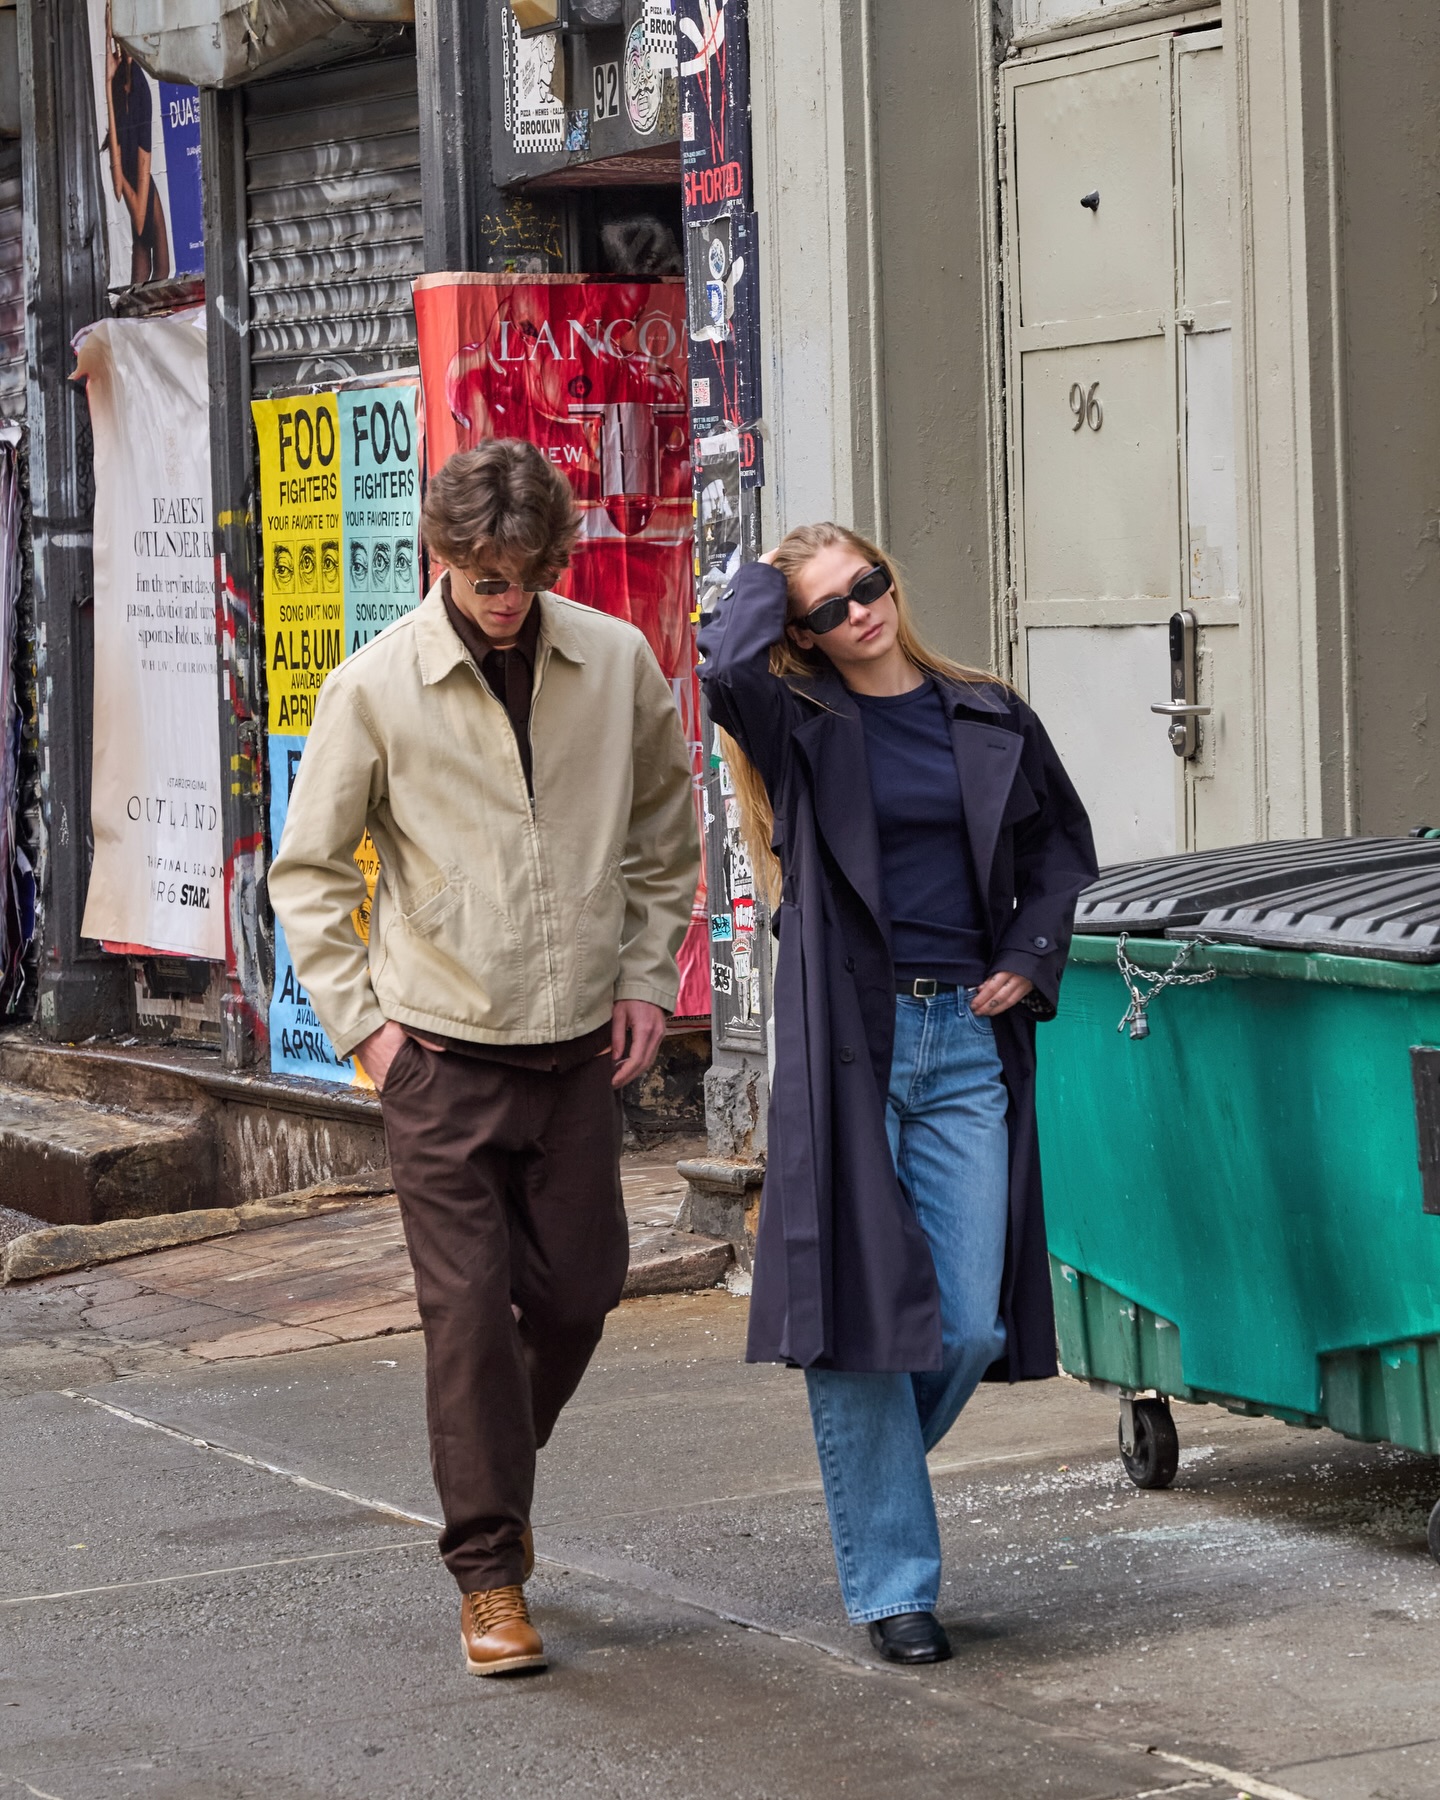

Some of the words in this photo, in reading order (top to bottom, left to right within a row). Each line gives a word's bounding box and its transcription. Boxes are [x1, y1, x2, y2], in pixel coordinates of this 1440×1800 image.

[595, 64, 618, 118] 92
[170, 97, 195, 128] DUA
[520, 109, 531, 117] PIZZA
[520, 119, 561, 136] BROOKLYN
[1069, 381, 1103, 431] 96
[278, 406, 335, 472] FOO
[353, 400, 411, 467] FOO
[280, 473, 337, 507] FIGHTERS
[354, 468, 414, 501] FIGHTERS
[267, 515, 290, 531] YOUR
[326, 514, 339, 529] TOY
[345, 511, 364, 527] YOUR
[280, 604, 304, 622] SONG
[322, 604, 341, 620] NOW
[356, 603, 377, 621] SONG
[272, 629, 341, 671] ALBUM
[291, 672, 329, 690] AVAILABL
[167, 883, 176, 903] 6
[282, 1028, 331, 1064] APRIL
